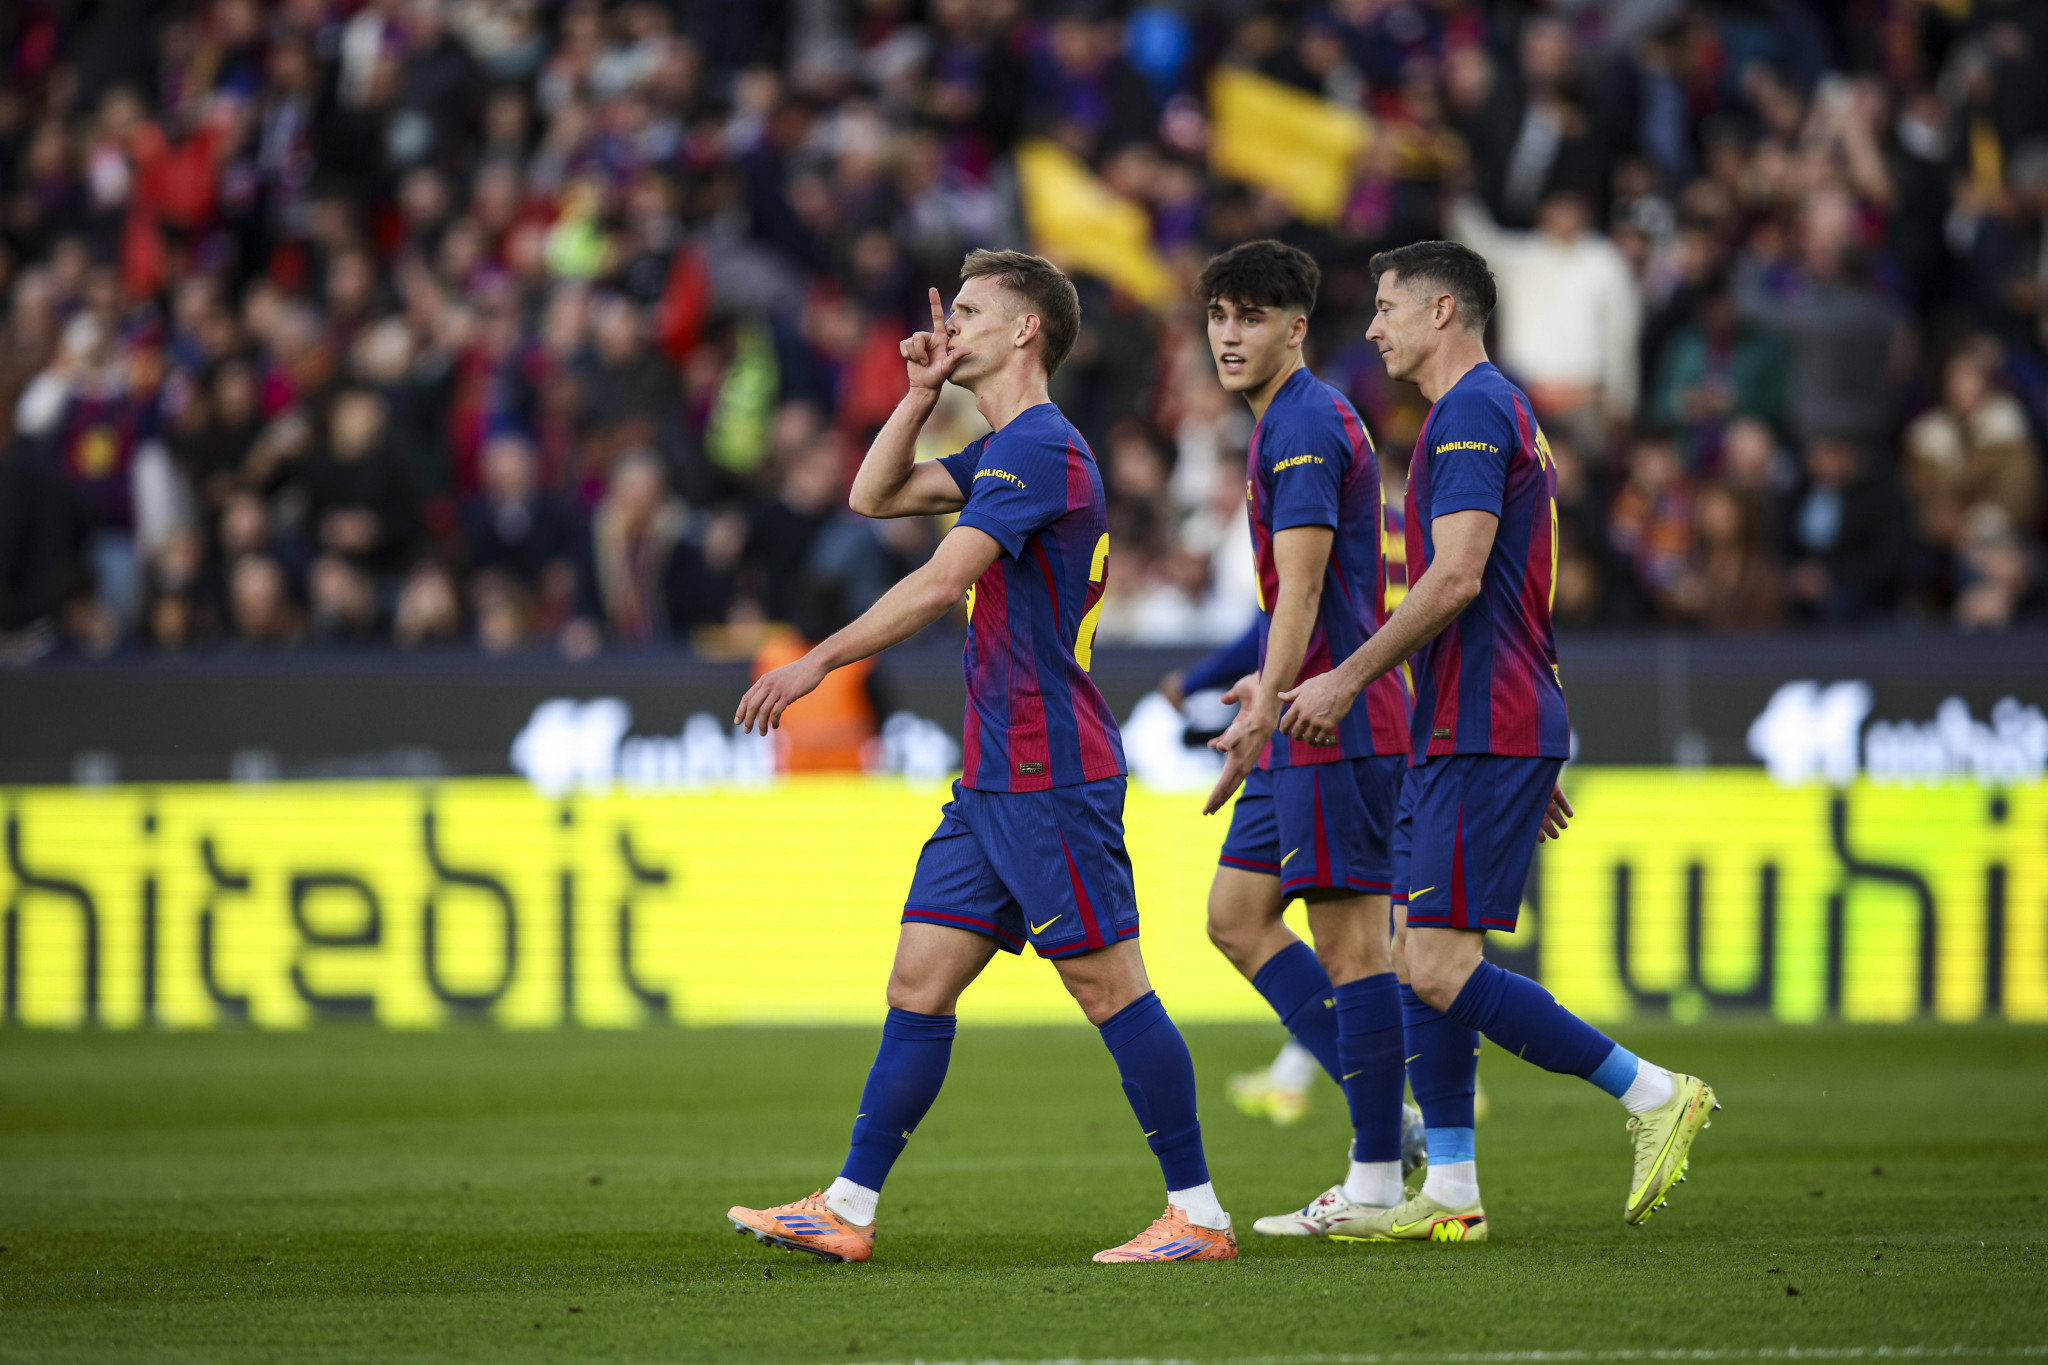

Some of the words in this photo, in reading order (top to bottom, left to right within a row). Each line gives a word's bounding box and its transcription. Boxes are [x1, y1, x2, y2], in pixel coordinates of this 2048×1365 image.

[1436, 441, 1487, 454] AMBILIGHT
[1489, 445, 1499, 453] tv
[1017, 480, 1027, 489] tv
